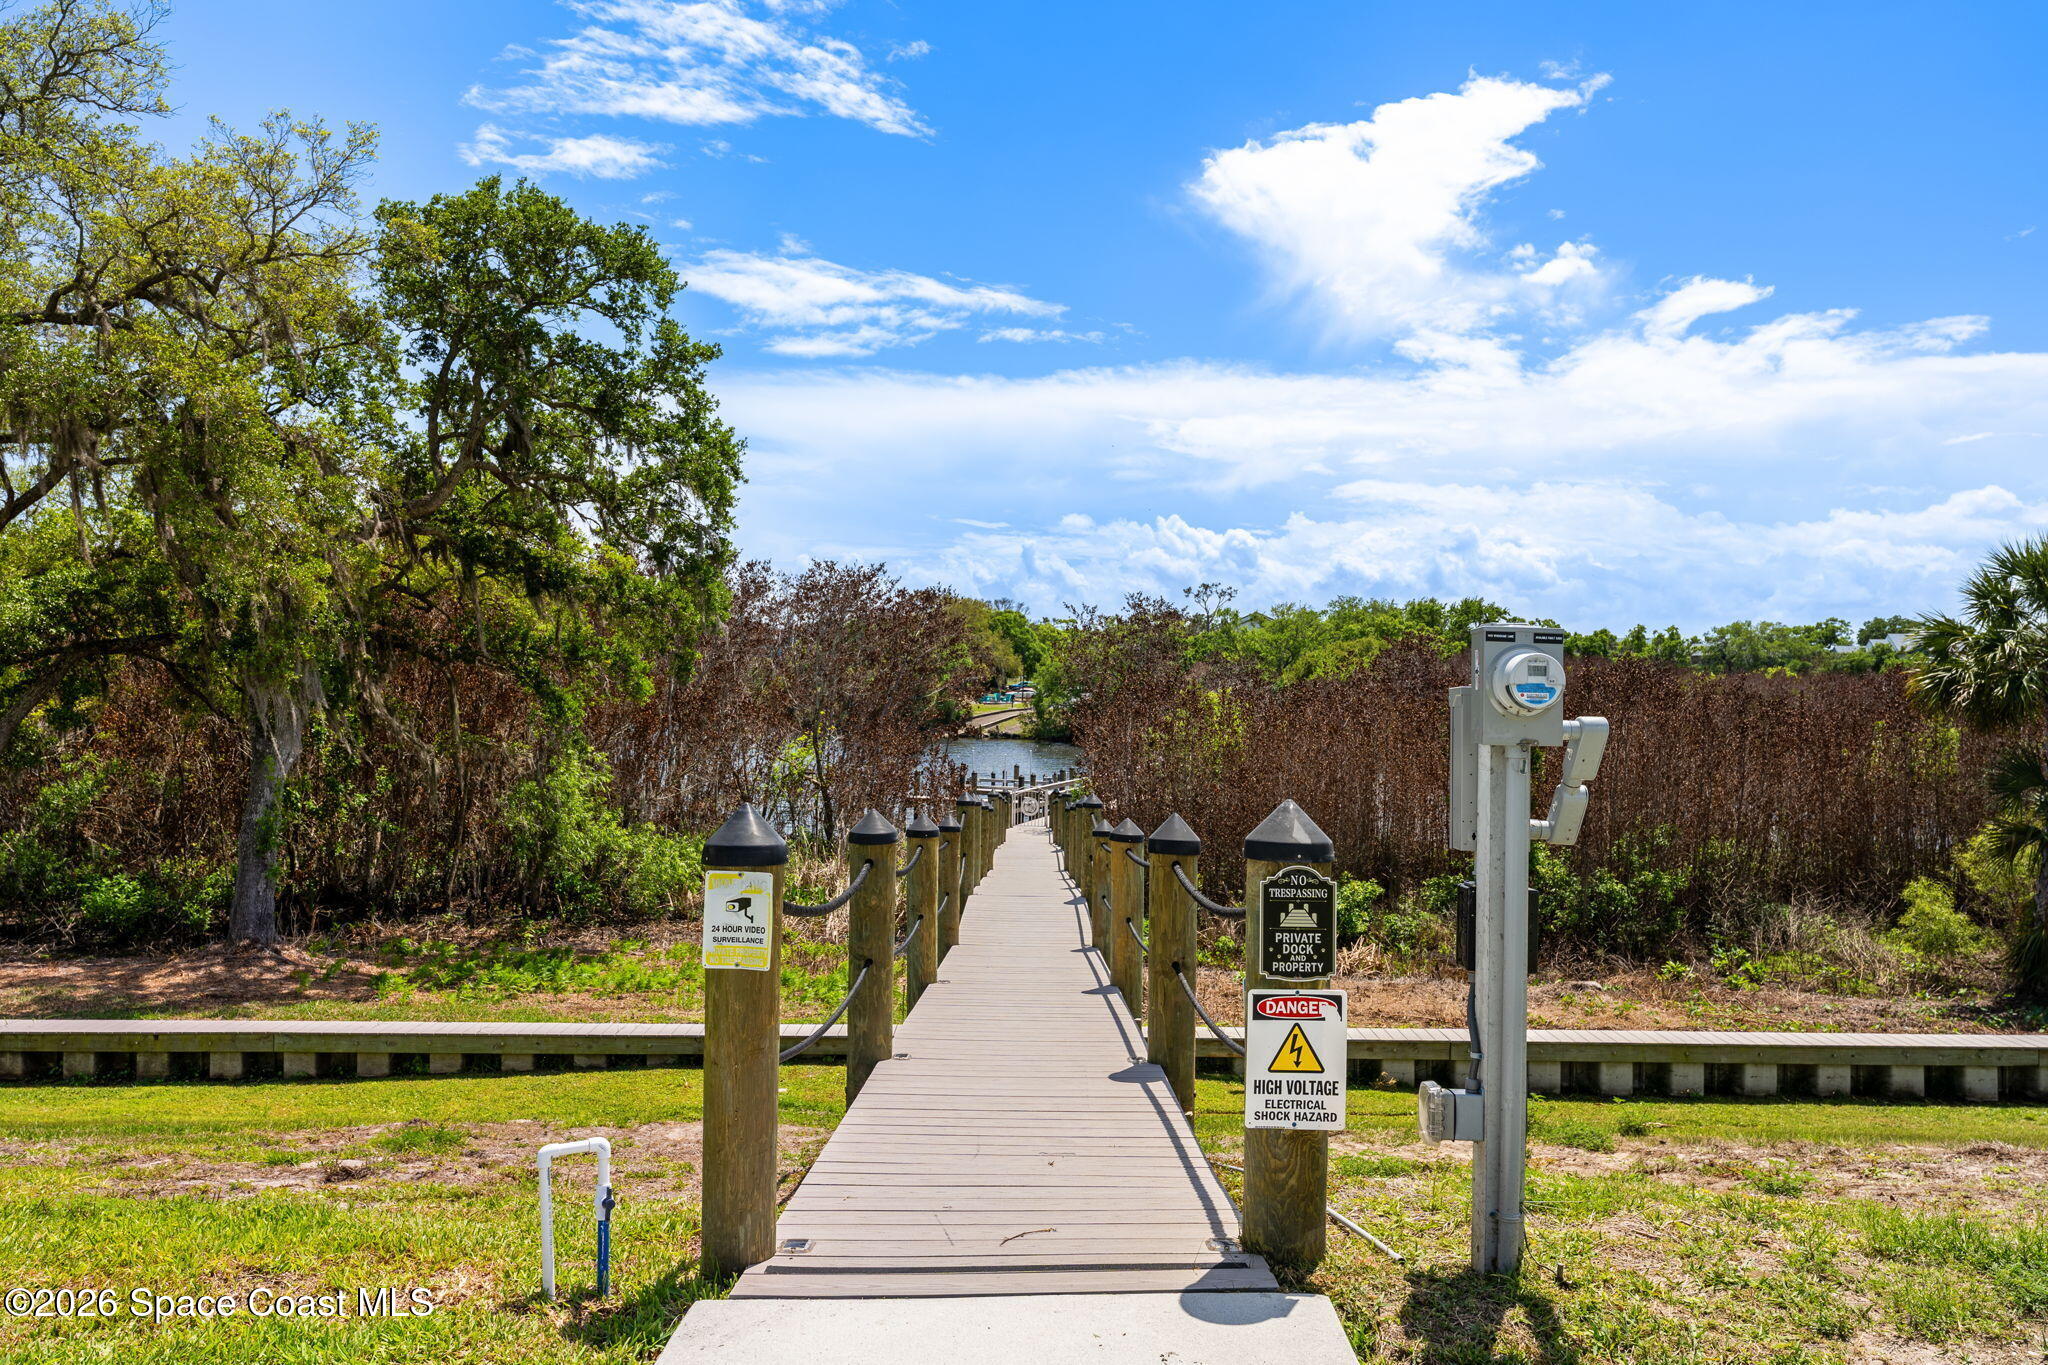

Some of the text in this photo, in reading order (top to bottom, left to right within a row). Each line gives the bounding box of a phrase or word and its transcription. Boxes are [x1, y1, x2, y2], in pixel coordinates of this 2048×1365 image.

[1290, 875, 1307, 886] NO
[1269, 888, 1328, 898] TRESPASSING
[711, 925, 766, 934] 24 HOUR VIDEO
[712, 936, 764, 945] SURVEILLANCE
[1275, 932, 1322, 944] PRIVATE
[1282, 944, 1314, 955] DOCK
[1272, 962, 1324, 973] PROPERTY
[1253, 1079, 1340, 1096] HIGH VOLTAGE
[1265, 1099, 1327, 1110] ELECTRICAL
[1254, 1111, 1338, 1123] SHOCK HAZARD
